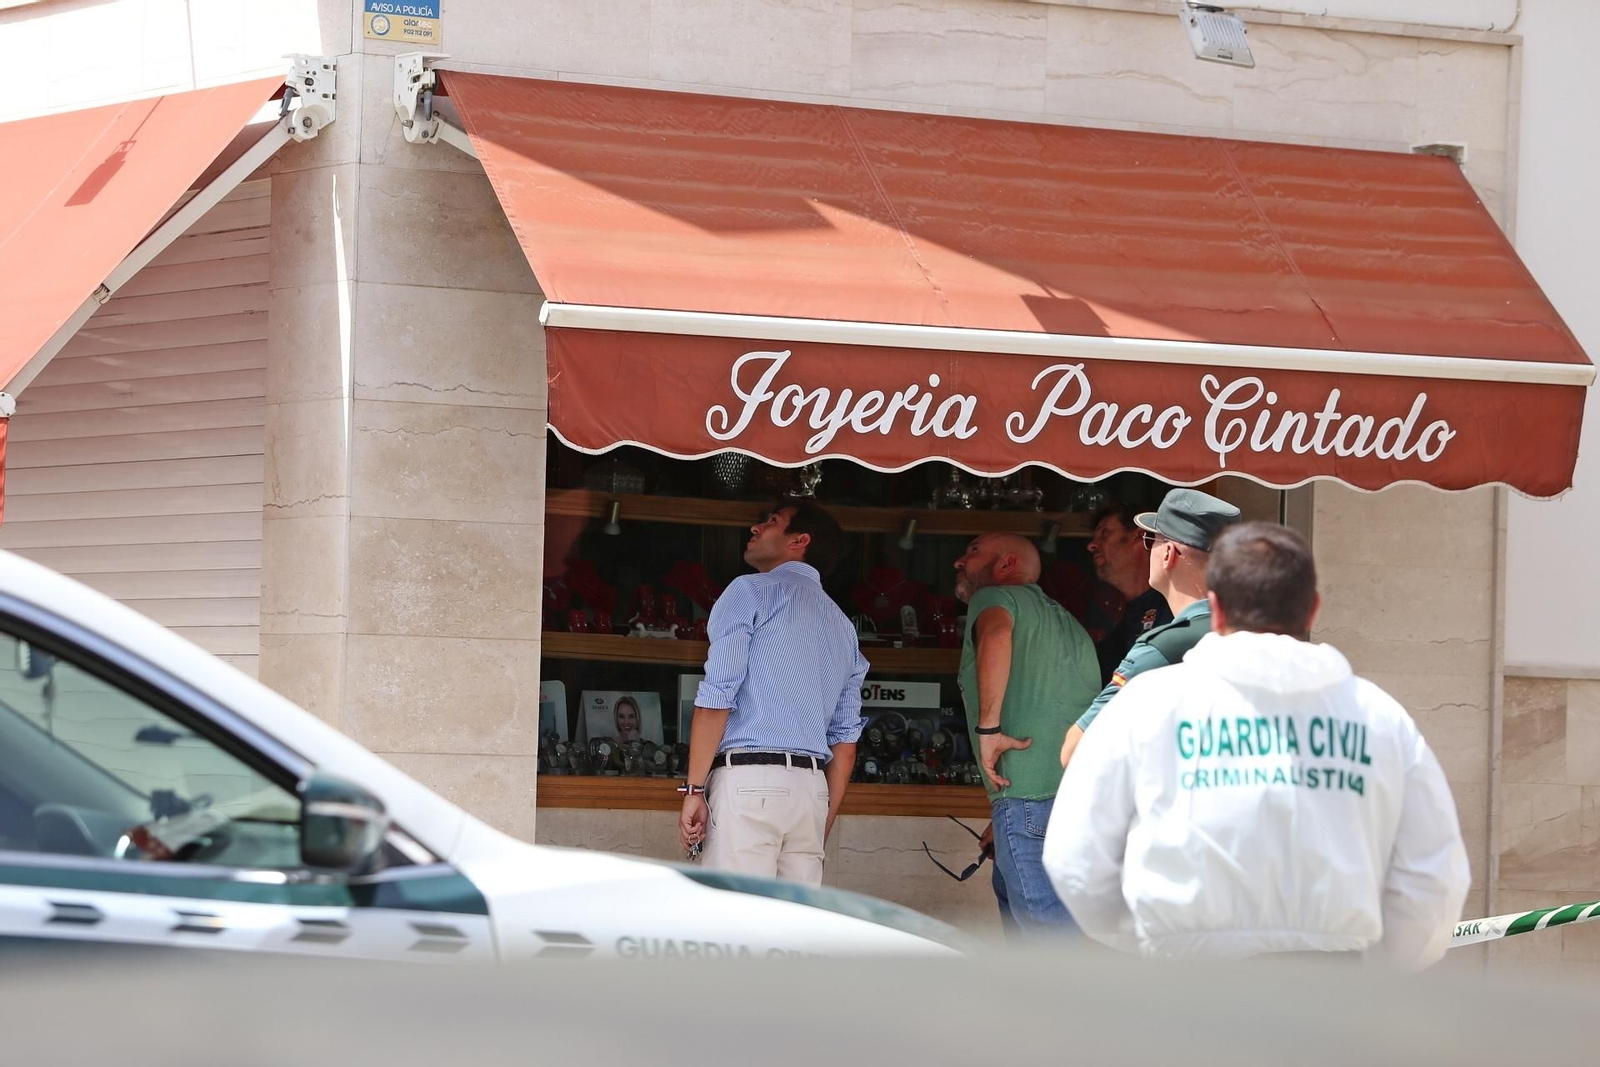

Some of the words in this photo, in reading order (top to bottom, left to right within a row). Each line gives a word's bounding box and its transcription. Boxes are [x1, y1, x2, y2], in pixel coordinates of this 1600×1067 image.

[371, 2, 394, 13] AVISO
[395, 4, 402, 13] A
[403, 5, 434, 17] POLICÍA
[705, 349, 978, 454] Joyeria
[1005, 362, 1192, 448] Paco
[1200, 373, 1457, 468] Cintado
[861, 684, 906, 701] OTENS
[1178, 716, 1300, 760] GUARDIA
[1309, 716, 1372, 766] CIVIL
[615, 935, 752, 960] GUARDIA
